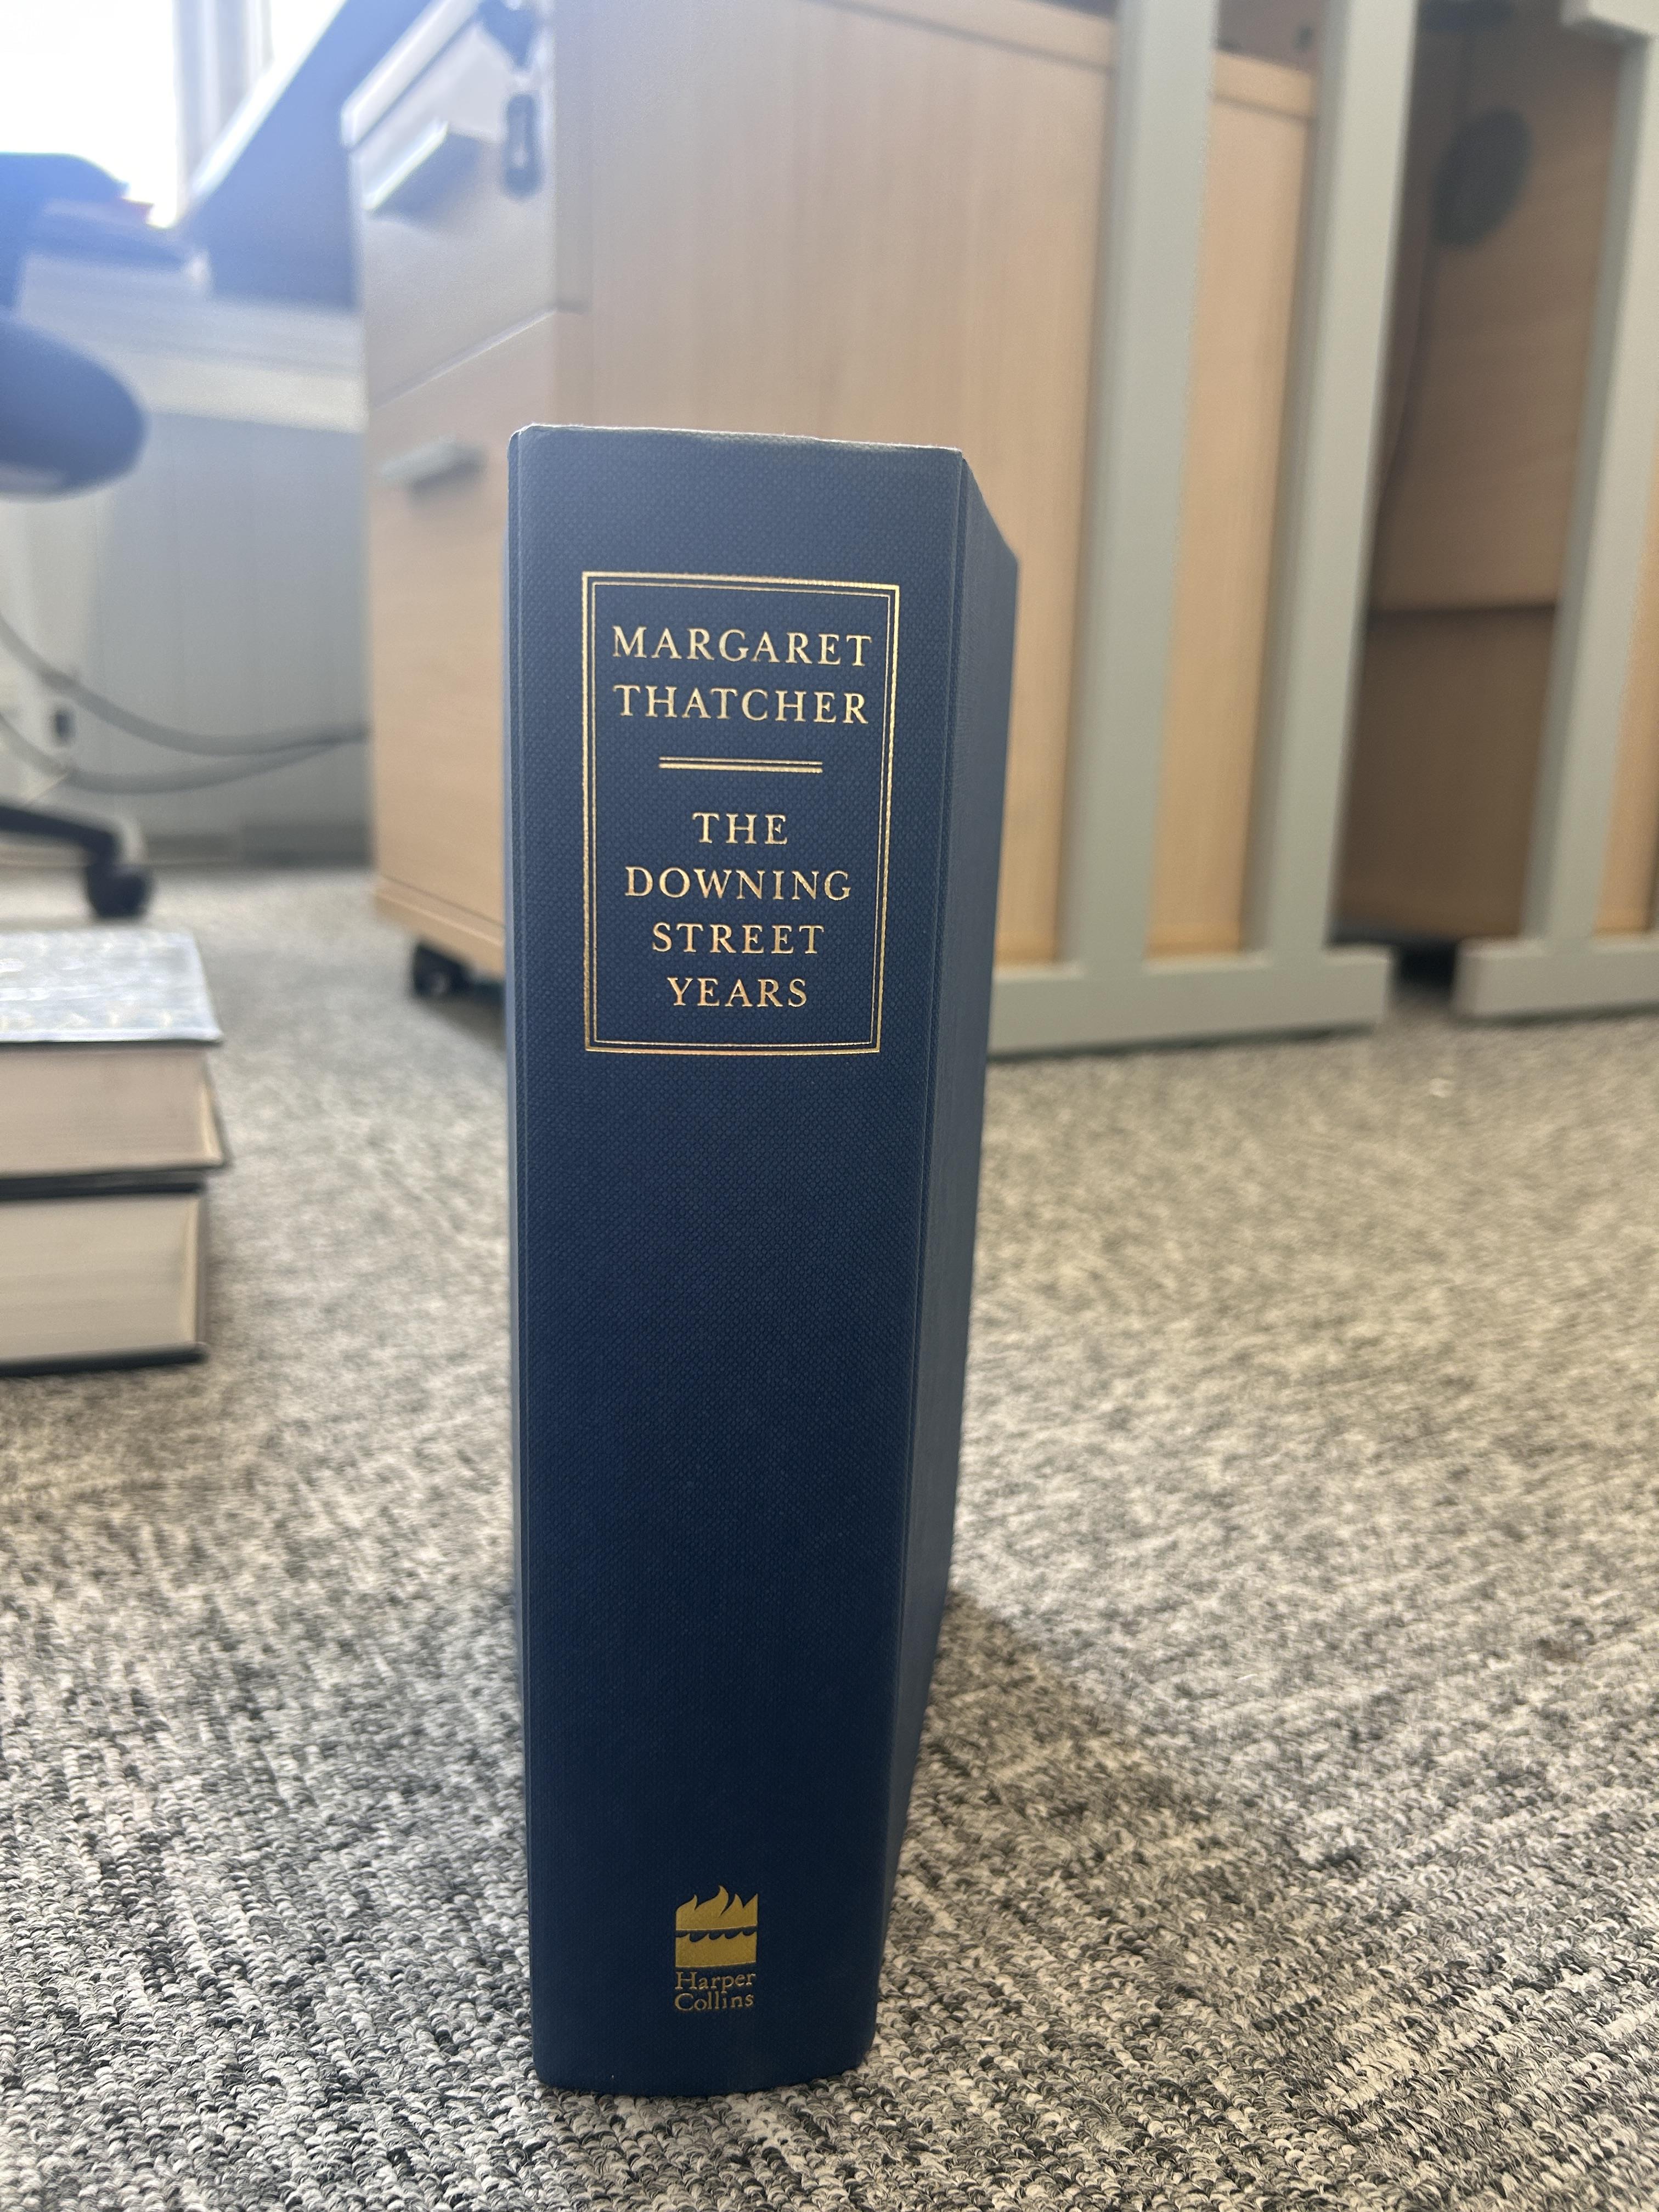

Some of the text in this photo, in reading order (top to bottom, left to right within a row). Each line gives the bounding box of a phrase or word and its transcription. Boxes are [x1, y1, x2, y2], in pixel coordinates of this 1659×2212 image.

[612, 625, 873, 667] MARGARET
[612, 684, 869, 725] THATCHER
[691, 811, 788, 845] THE
[624, 866, 851, 901] DOWNING
[652, 922, 825, 954] STREET
[667, 977, 808, 1007] YEARS
[674, 1971, 757, 1993] Harper
[674, 1991, 755, 2011] Collins
